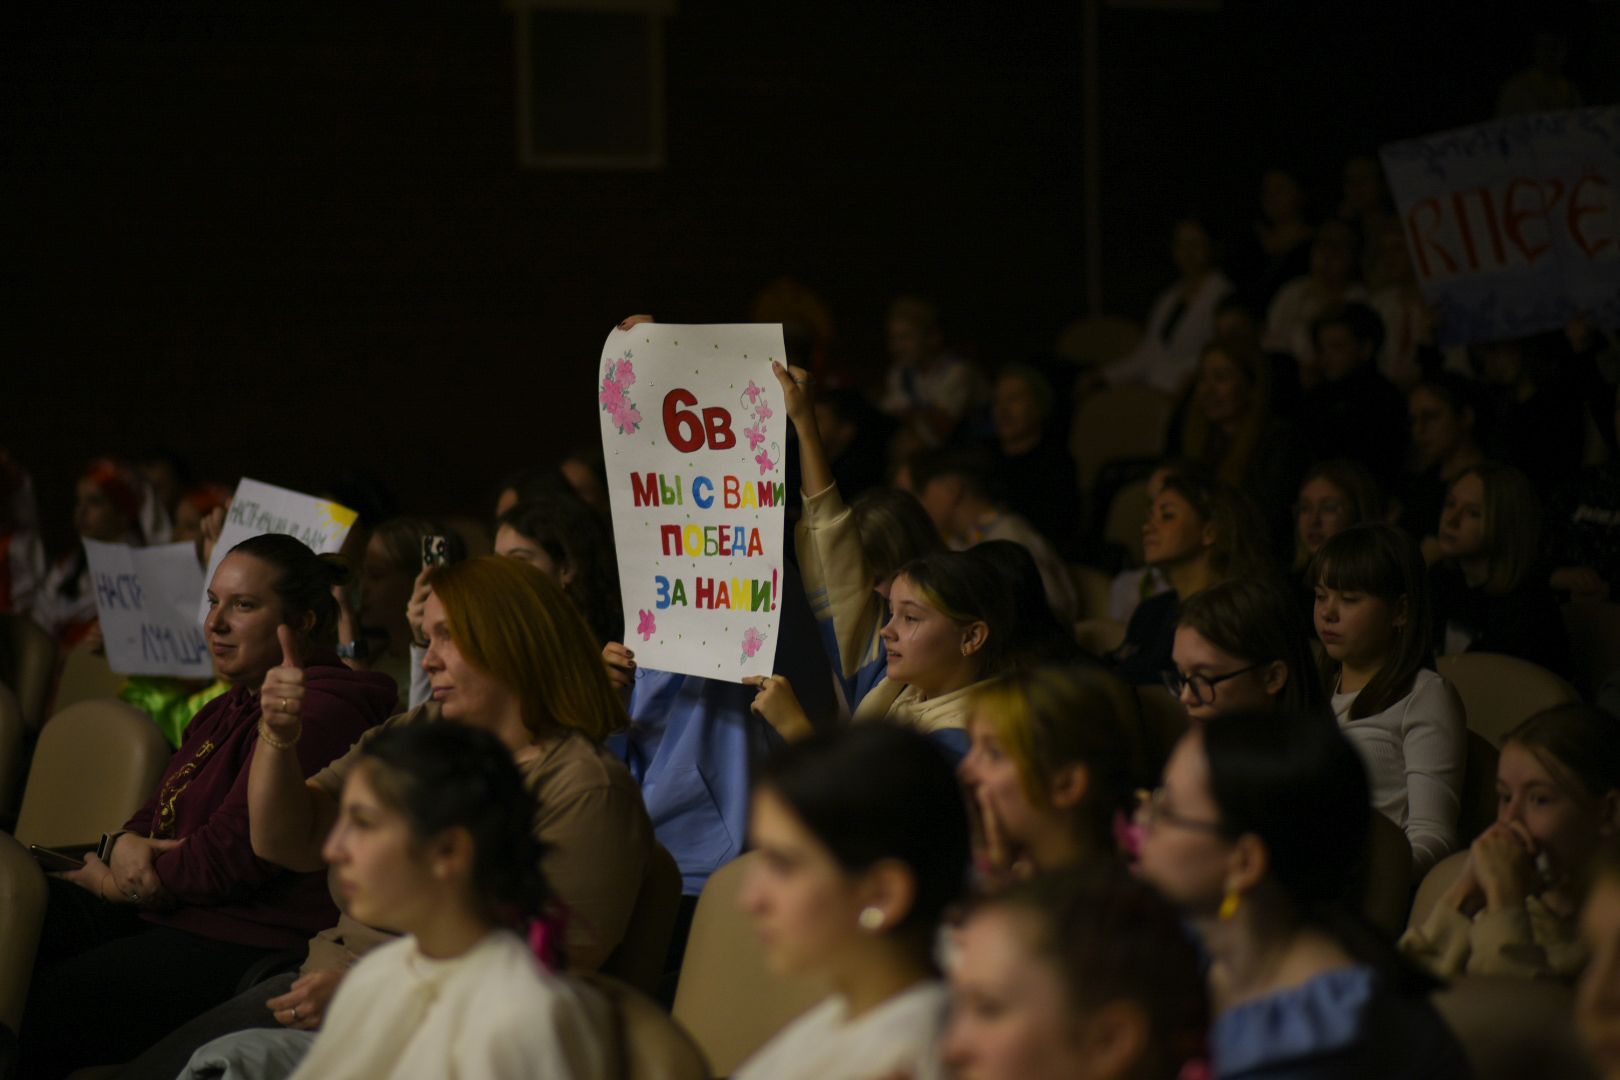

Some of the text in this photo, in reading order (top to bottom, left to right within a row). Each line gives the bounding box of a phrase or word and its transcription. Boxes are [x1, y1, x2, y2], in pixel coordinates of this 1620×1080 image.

[630, 471, 785, 509] МЫ С ВАМИ
[660, 524, 763, 557] ПОБЕДА
[655, 567, 778, 613] ЗА НАМИ!
